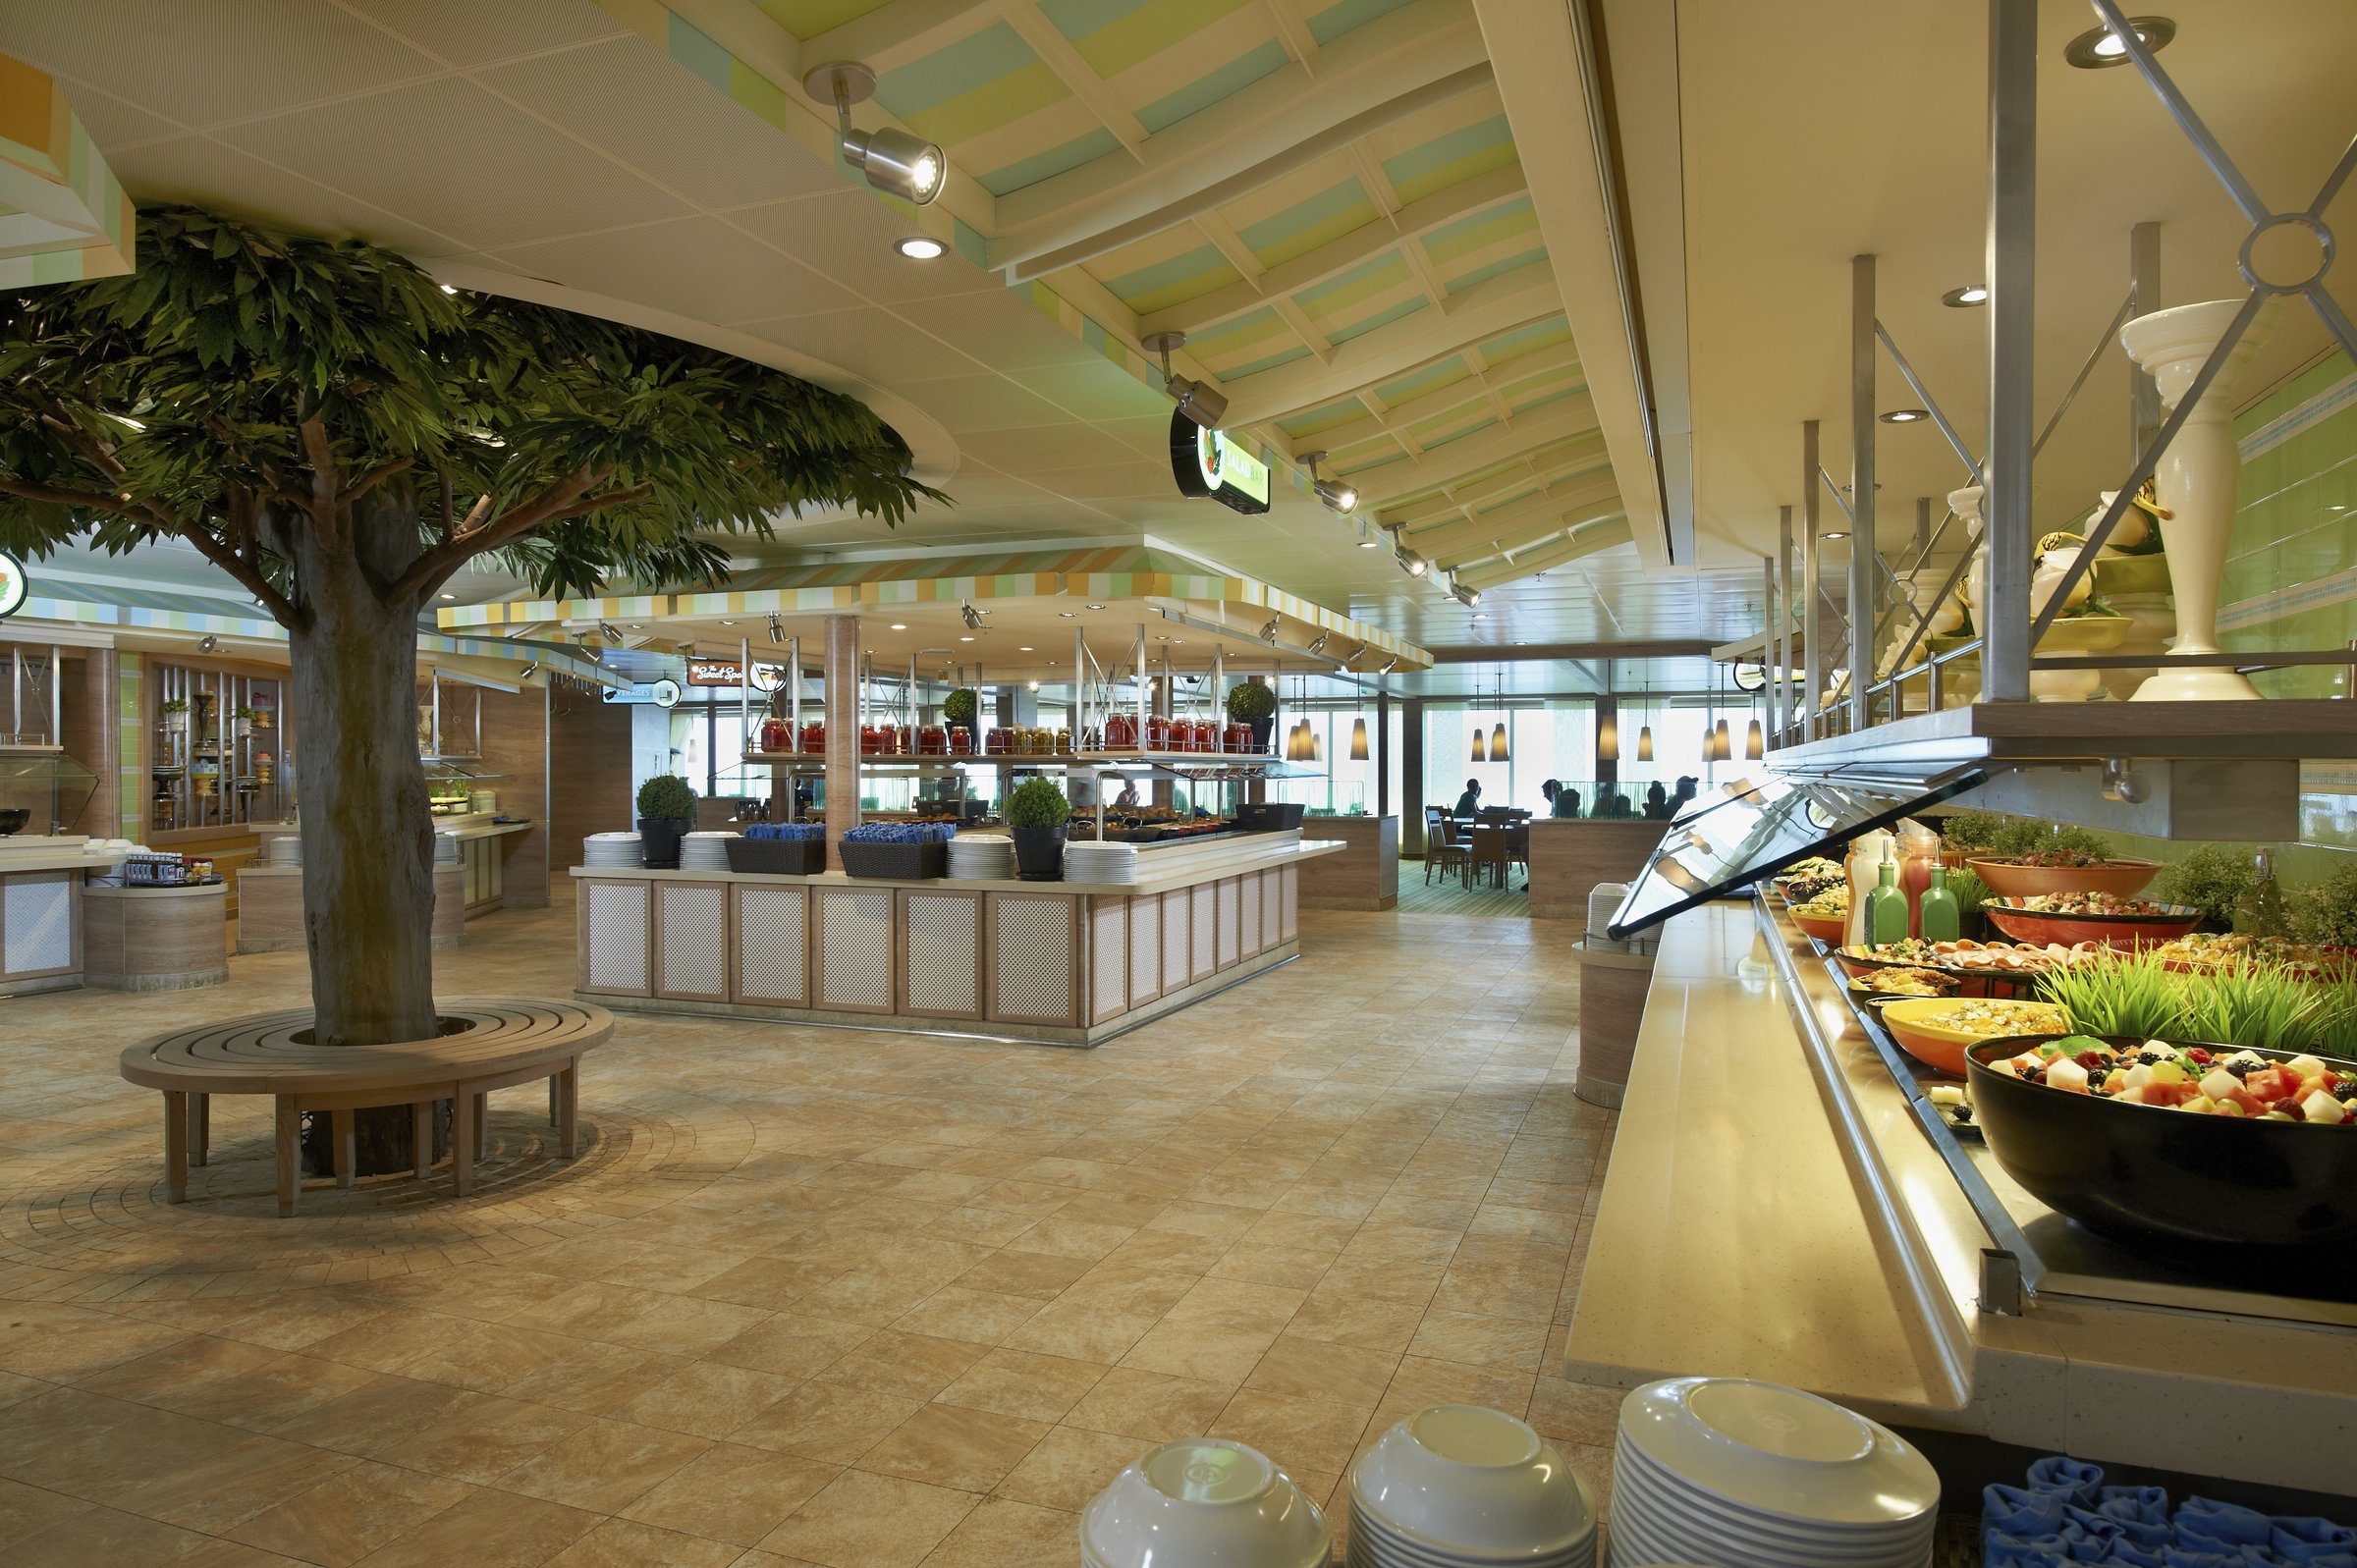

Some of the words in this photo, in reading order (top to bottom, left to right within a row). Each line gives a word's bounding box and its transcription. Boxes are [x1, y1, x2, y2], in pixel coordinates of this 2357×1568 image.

[1227, 450, 1251, 478] SALAD
[1250, 465, 1264, 487] BAR
[697, 666, 725, 679] Sweet
[725, 667, 743, 682] Spo
